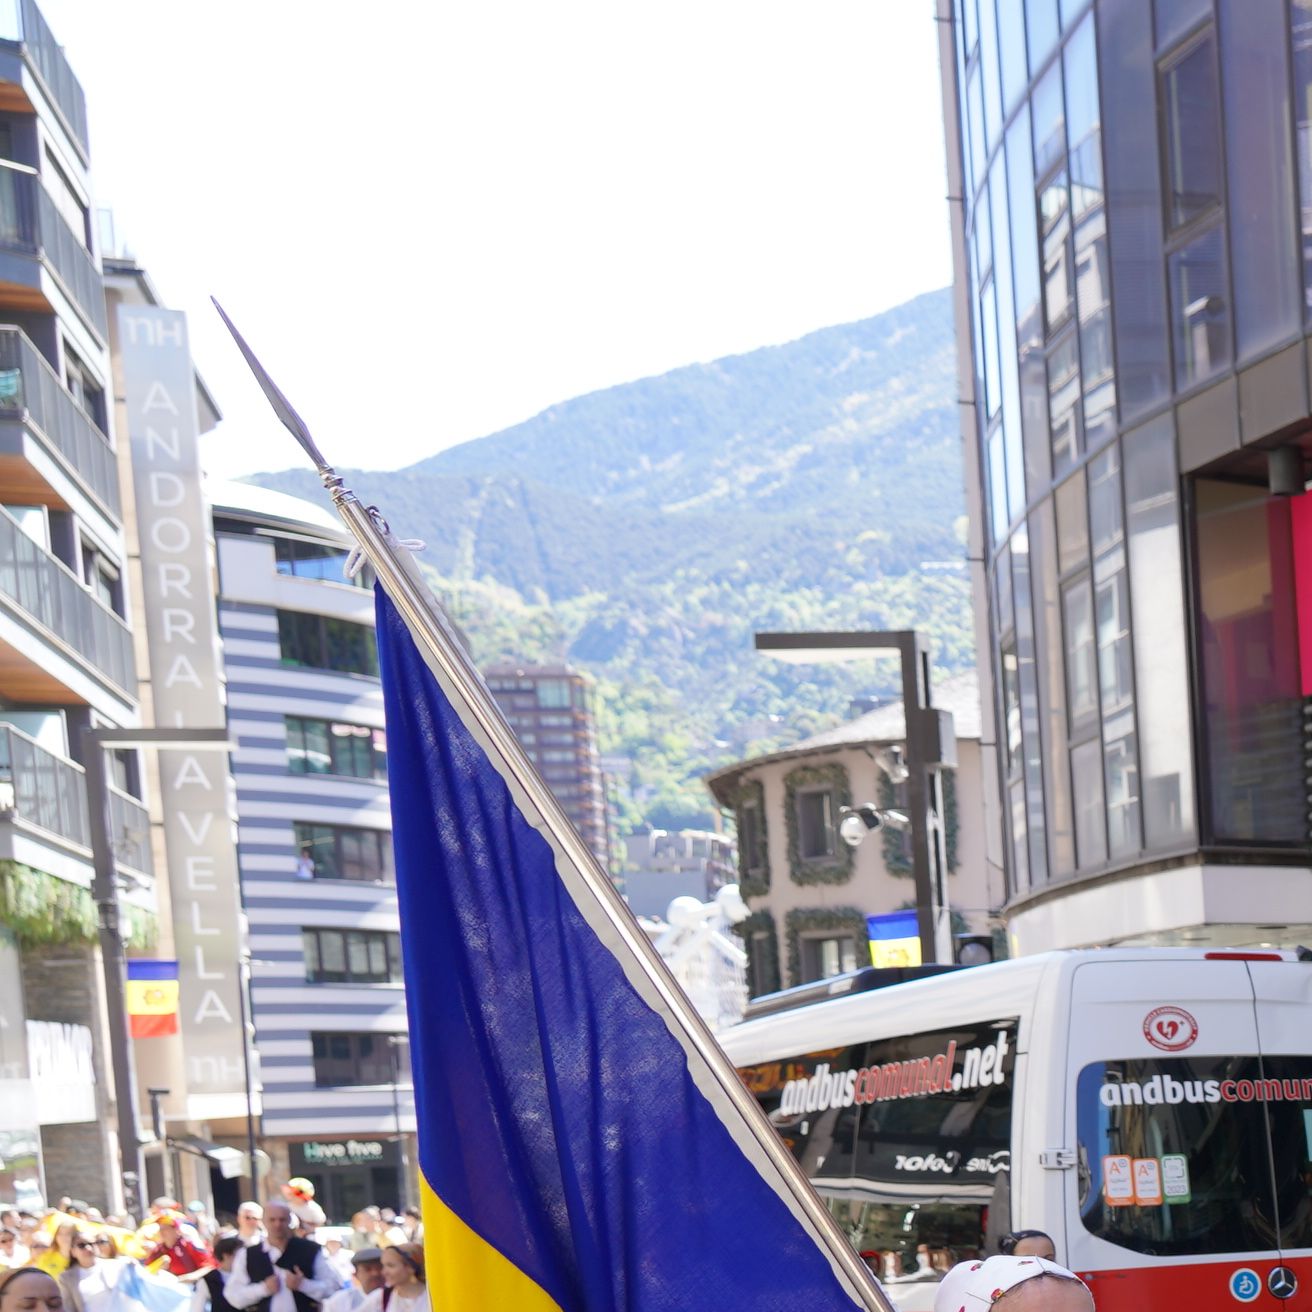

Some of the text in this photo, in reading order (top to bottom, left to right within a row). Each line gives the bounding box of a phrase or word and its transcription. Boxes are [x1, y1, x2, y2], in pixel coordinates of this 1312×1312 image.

[141, 380, 203, 689] ANDORRA
[178, 812, 233, 1024] VELLA
[780, 1030, 1010, 1117] andbuscomunal.net
